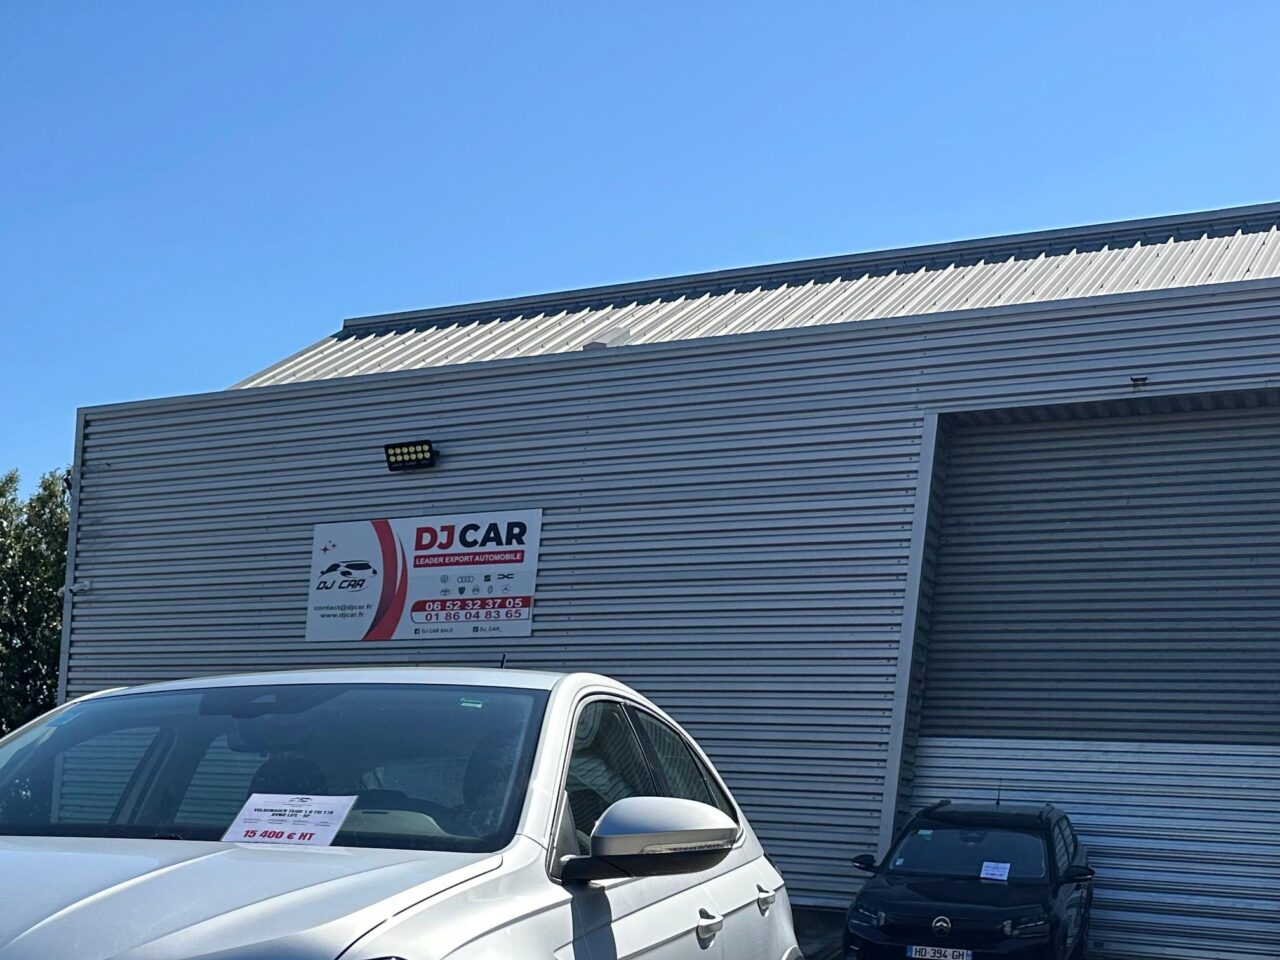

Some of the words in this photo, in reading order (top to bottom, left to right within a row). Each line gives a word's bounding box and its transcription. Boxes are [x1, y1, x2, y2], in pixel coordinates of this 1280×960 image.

[415, 525, 455, 551] DJ
[458, 521, 527, 548] CAR
[415, 556, 444, 565] LEADER
[445, 555, 474, 563] EXPORT
[473, 552, 522, 562] AUTOMOBILE
[316, 580, 336, 591] DJ
[338, 579, 366, 589] CAR
[425, 601, 441, 611] 06
[445, 601, 461, 610] 52
[465, 600, 481, 609] 32
[485, 599, 501, 608] 37
[506, 598, 523, 607] 05
[425, 613, 440, 621] 01
[445, 612, 460, 621] 86
[464, 611, 480, 620] 04
[485, 610, 500, 619] 83
[505, 609, 522, 618] 65
[243, 830, 257, 838] 15
[259, 830, 284, 839] 400
[287, 832, 296, 840] €
[298, 832, 316, 841] HT
